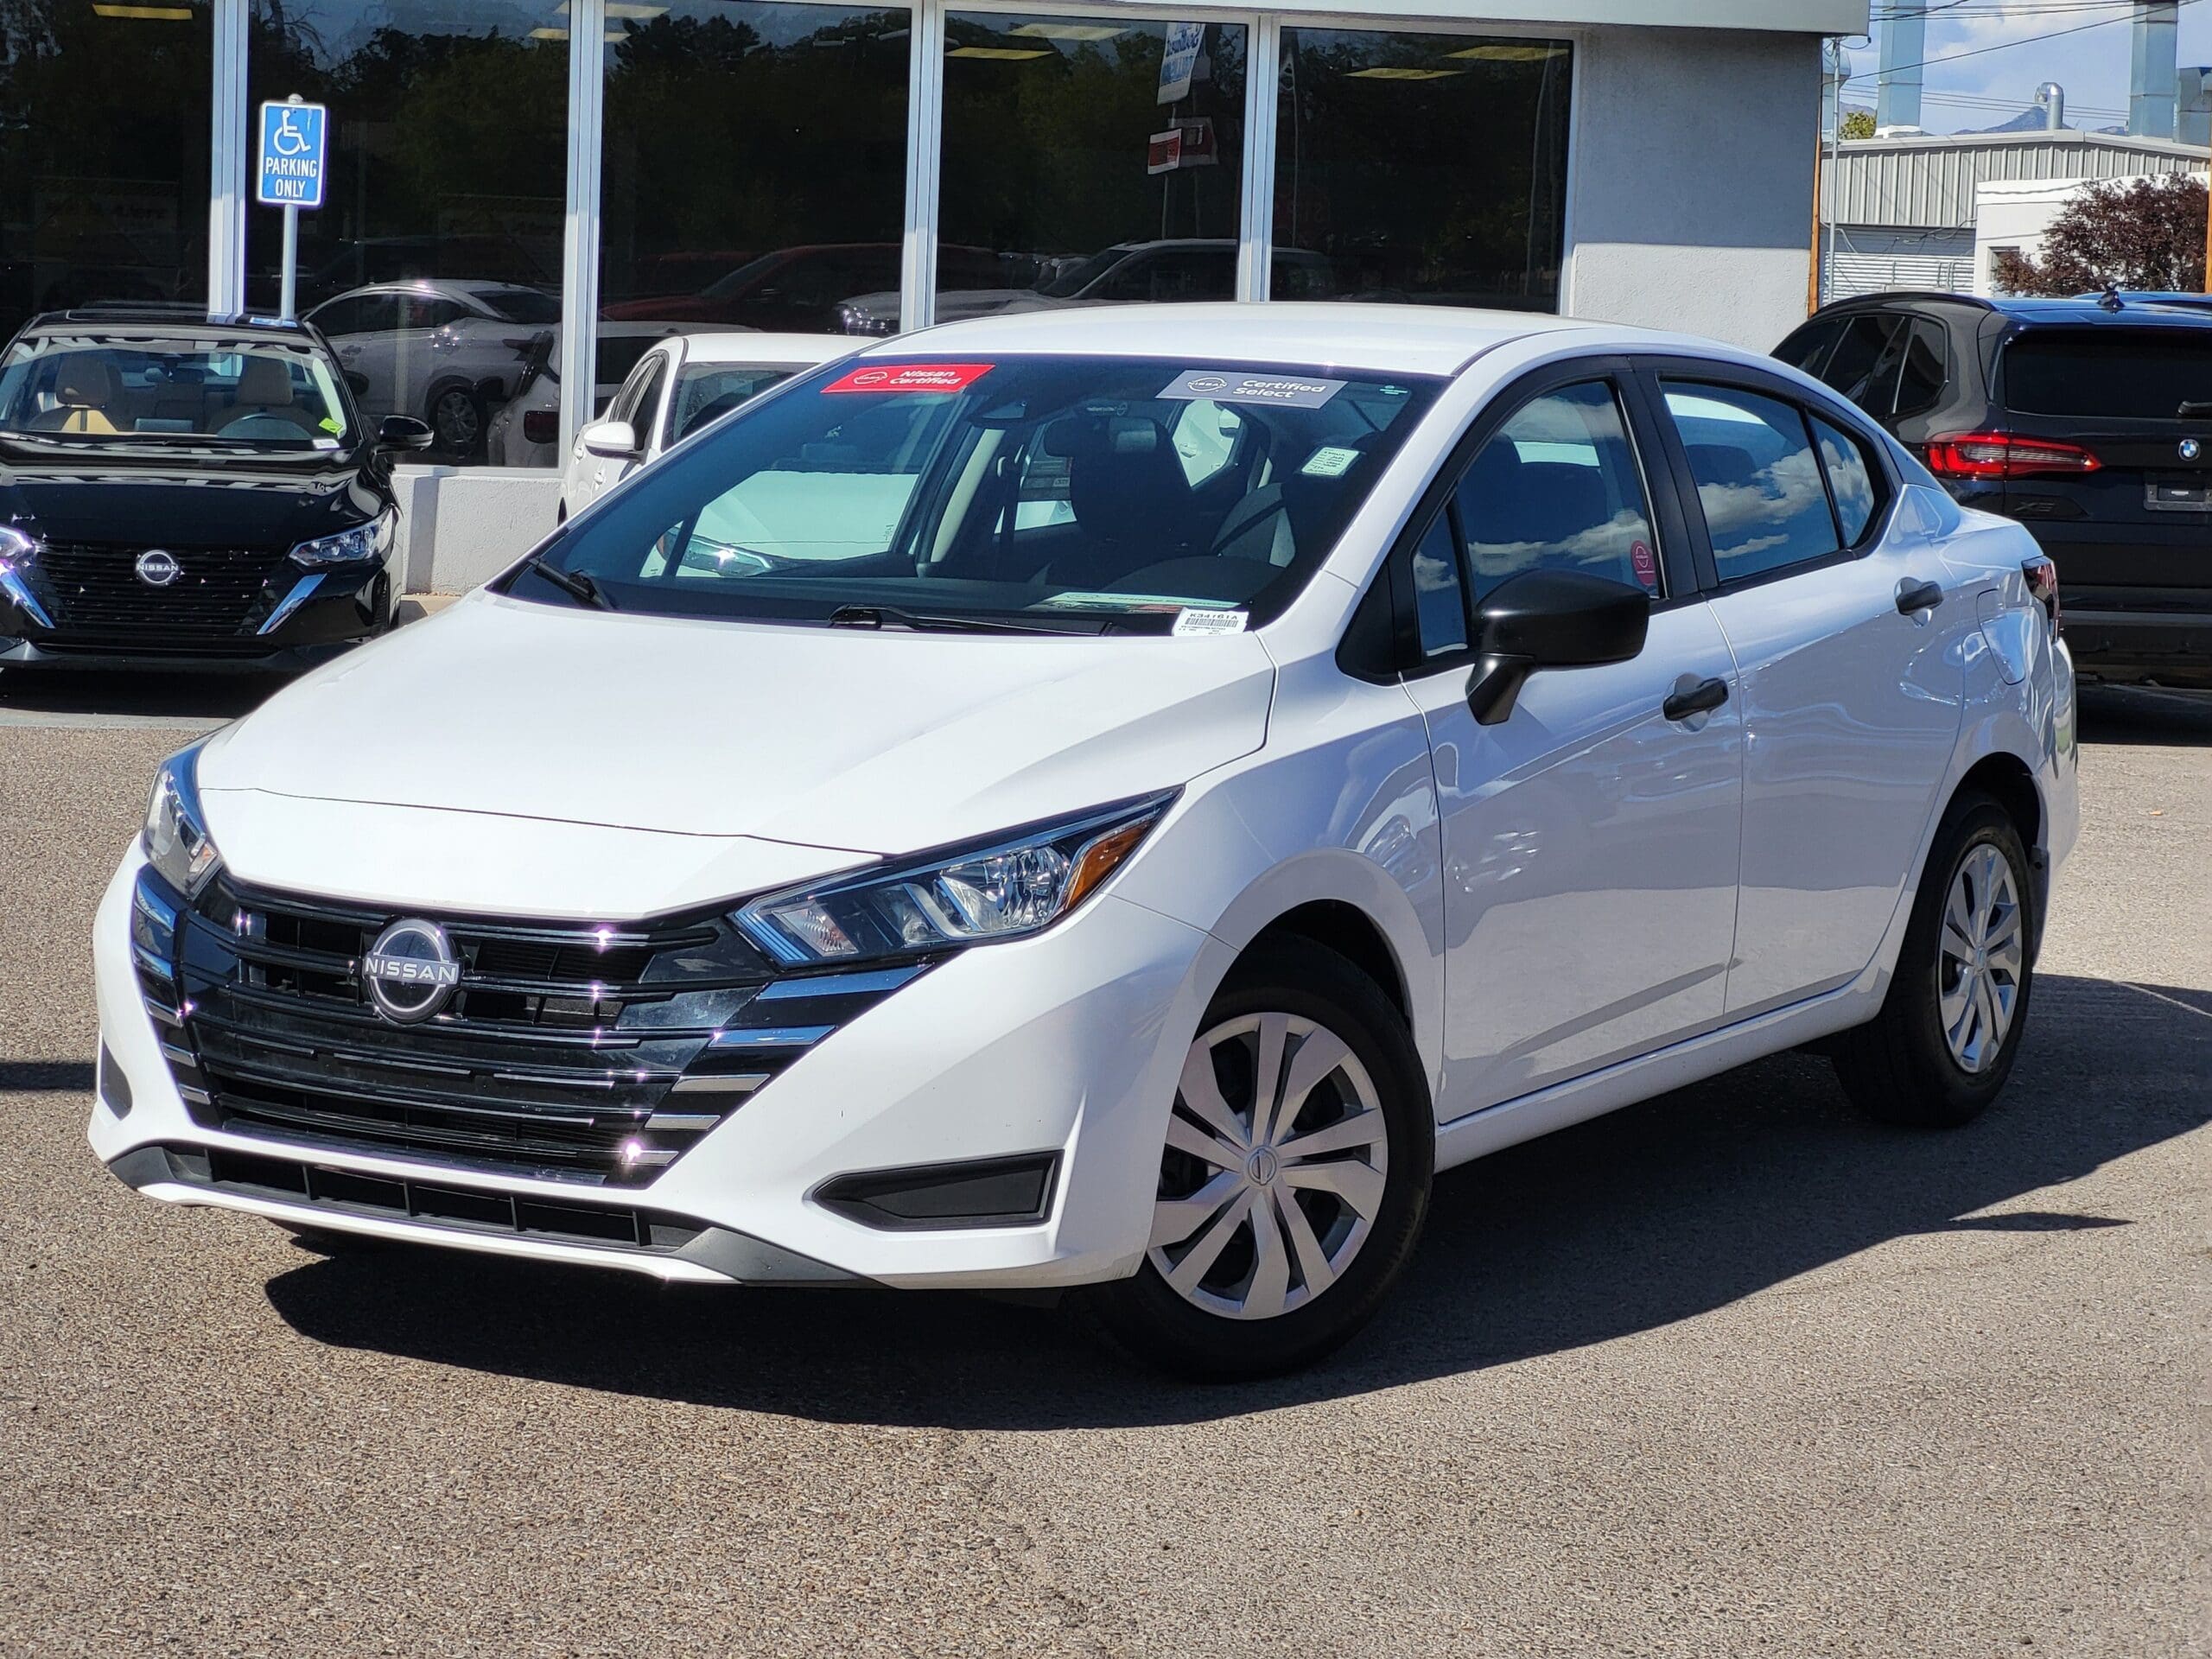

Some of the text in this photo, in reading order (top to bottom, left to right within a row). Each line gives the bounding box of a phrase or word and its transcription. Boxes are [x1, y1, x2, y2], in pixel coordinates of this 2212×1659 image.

[265, 157, 317, 177] PARKING
[275, 179, 306, 198] ONLY
[889, 377, 962, 385] Certified
[1243, 379, 1326, 393] Certified
[1232, 387, 1294, 398] Select
[365, 957, 456, 982] NISSAN
